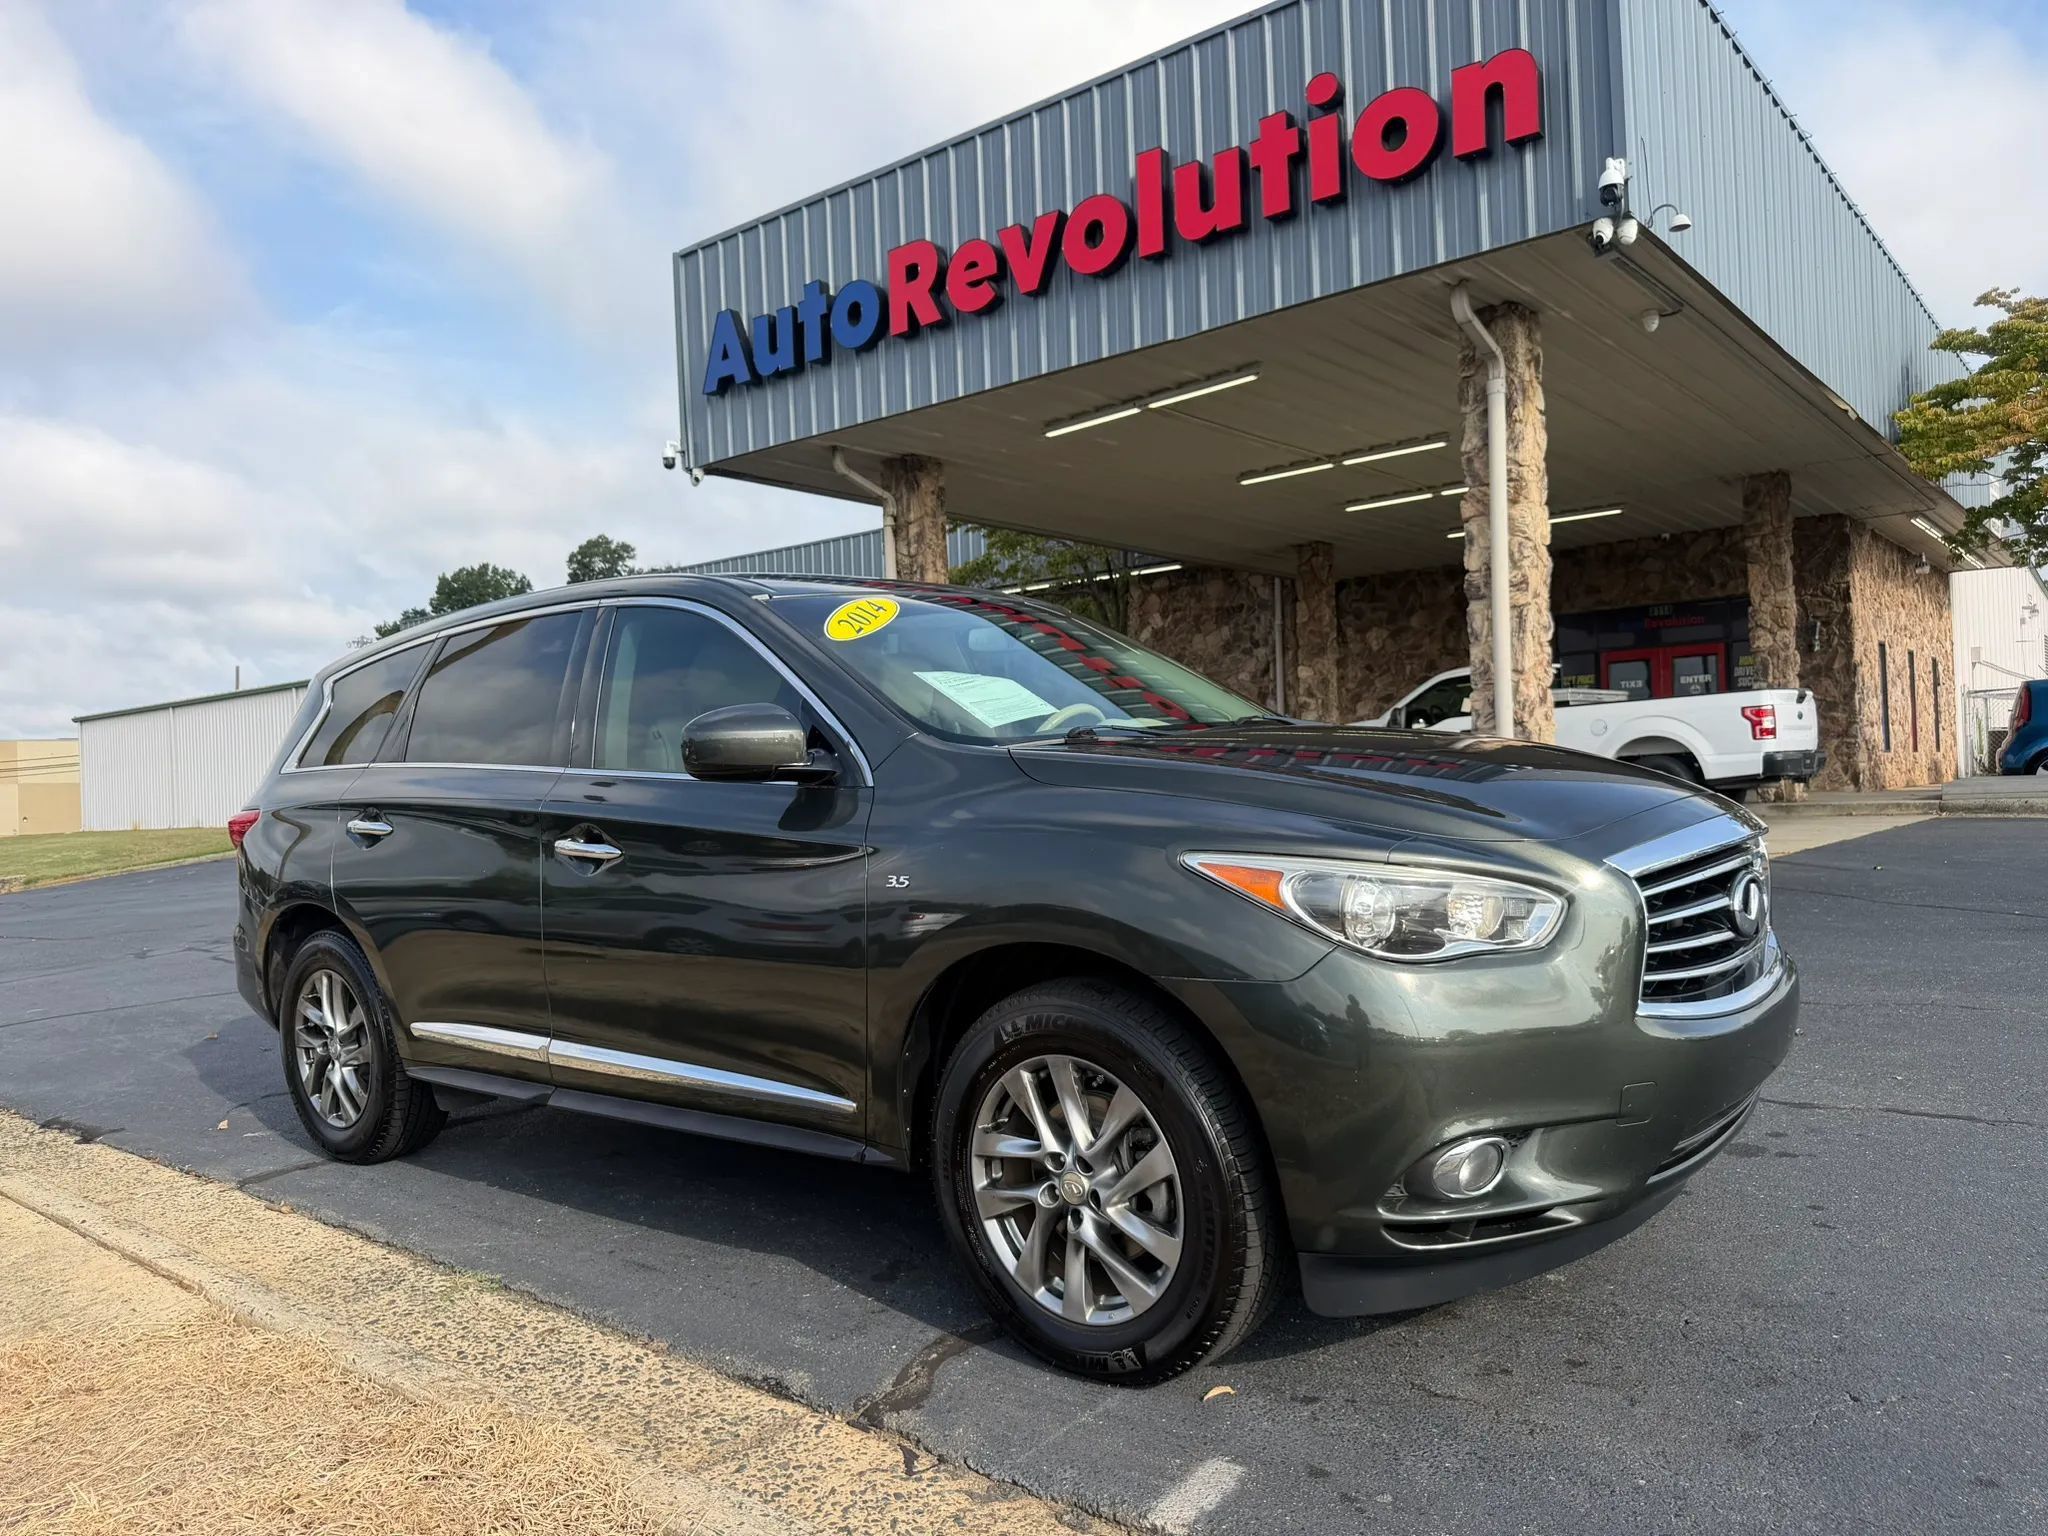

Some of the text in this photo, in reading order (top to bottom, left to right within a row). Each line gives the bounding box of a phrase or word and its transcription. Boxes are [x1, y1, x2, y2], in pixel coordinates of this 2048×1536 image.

[703, 47, 1544, 396] AutoRevolution
[838, 600, 887, 634] 2014
[1680, 674, 1712, 684] ENTER
